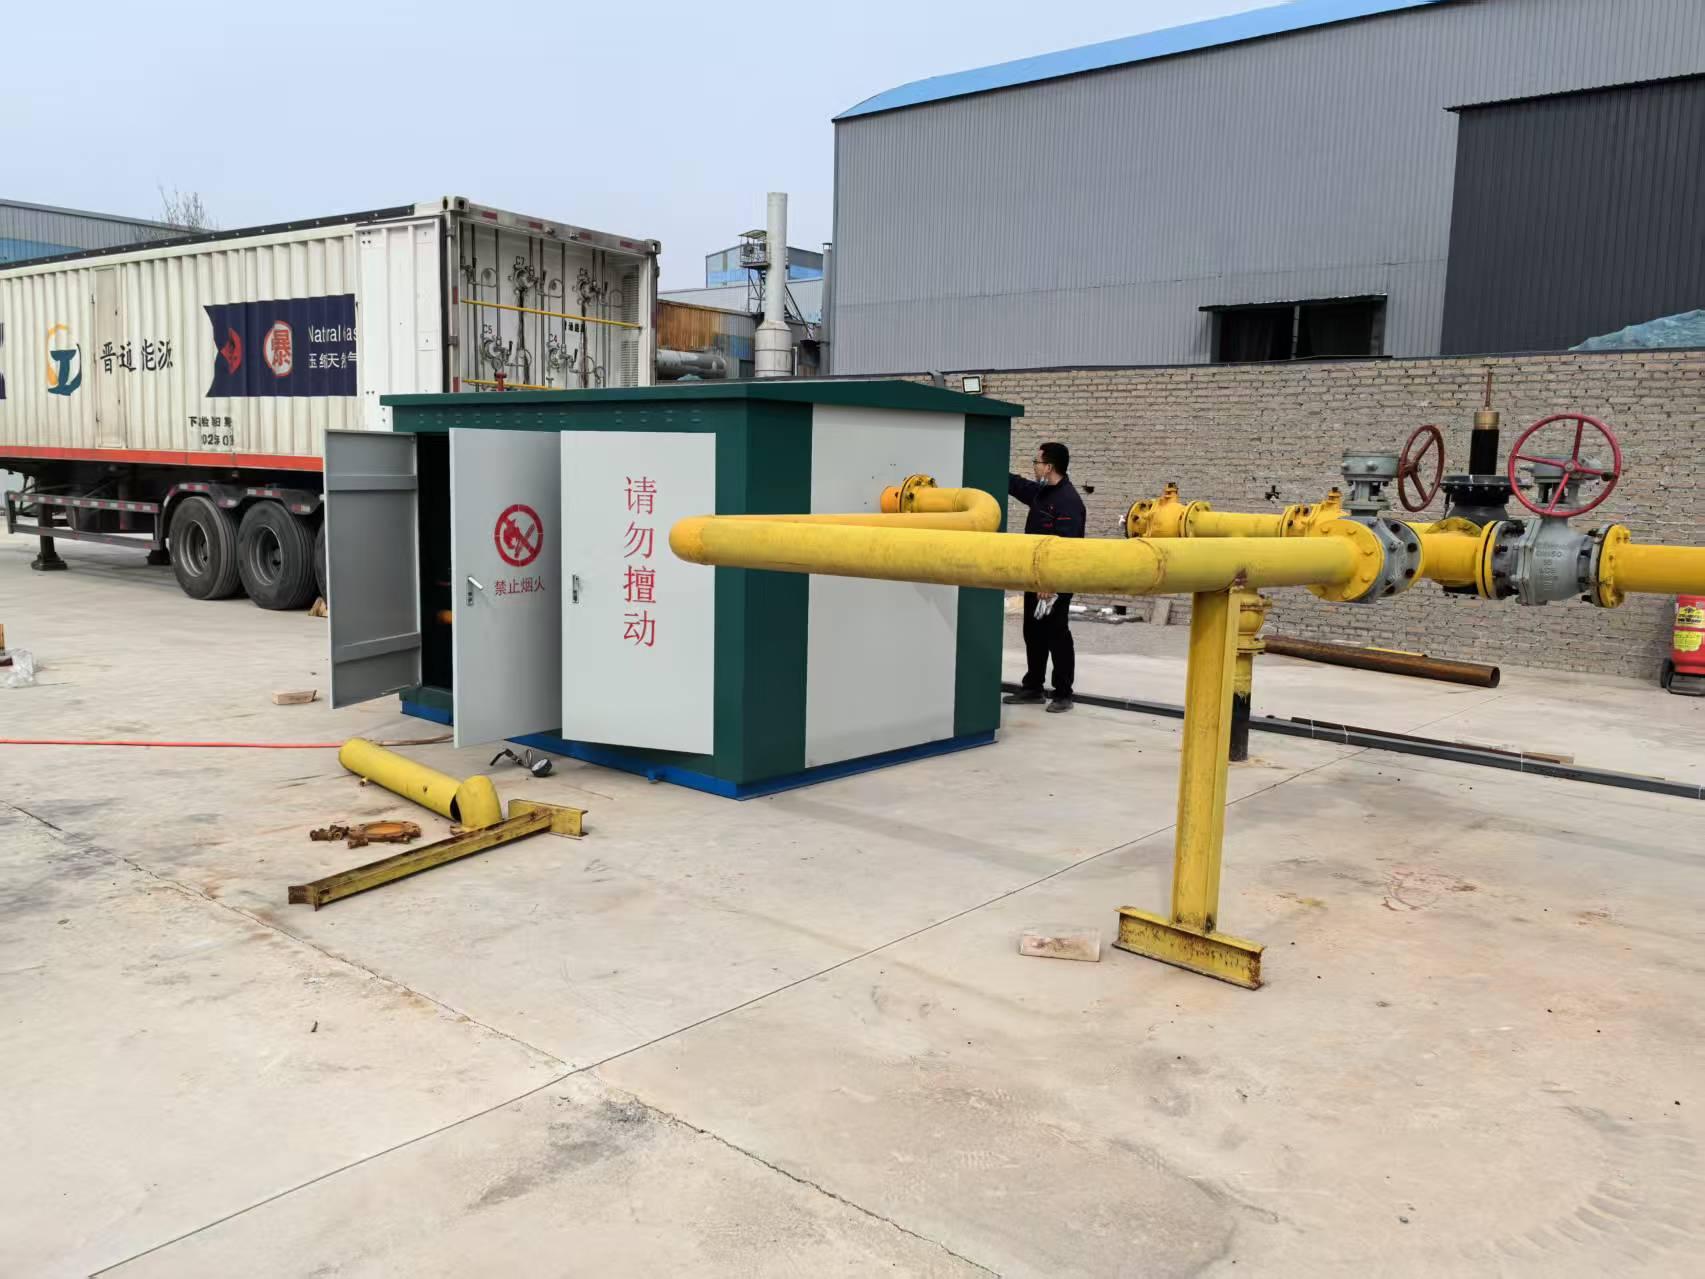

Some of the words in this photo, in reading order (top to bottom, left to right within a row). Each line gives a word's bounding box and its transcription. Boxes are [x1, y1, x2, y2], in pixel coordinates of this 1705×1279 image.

[494, 575, 545, 596] 禁止烟火
[624, 476, 657, 647] 请勿擅动
